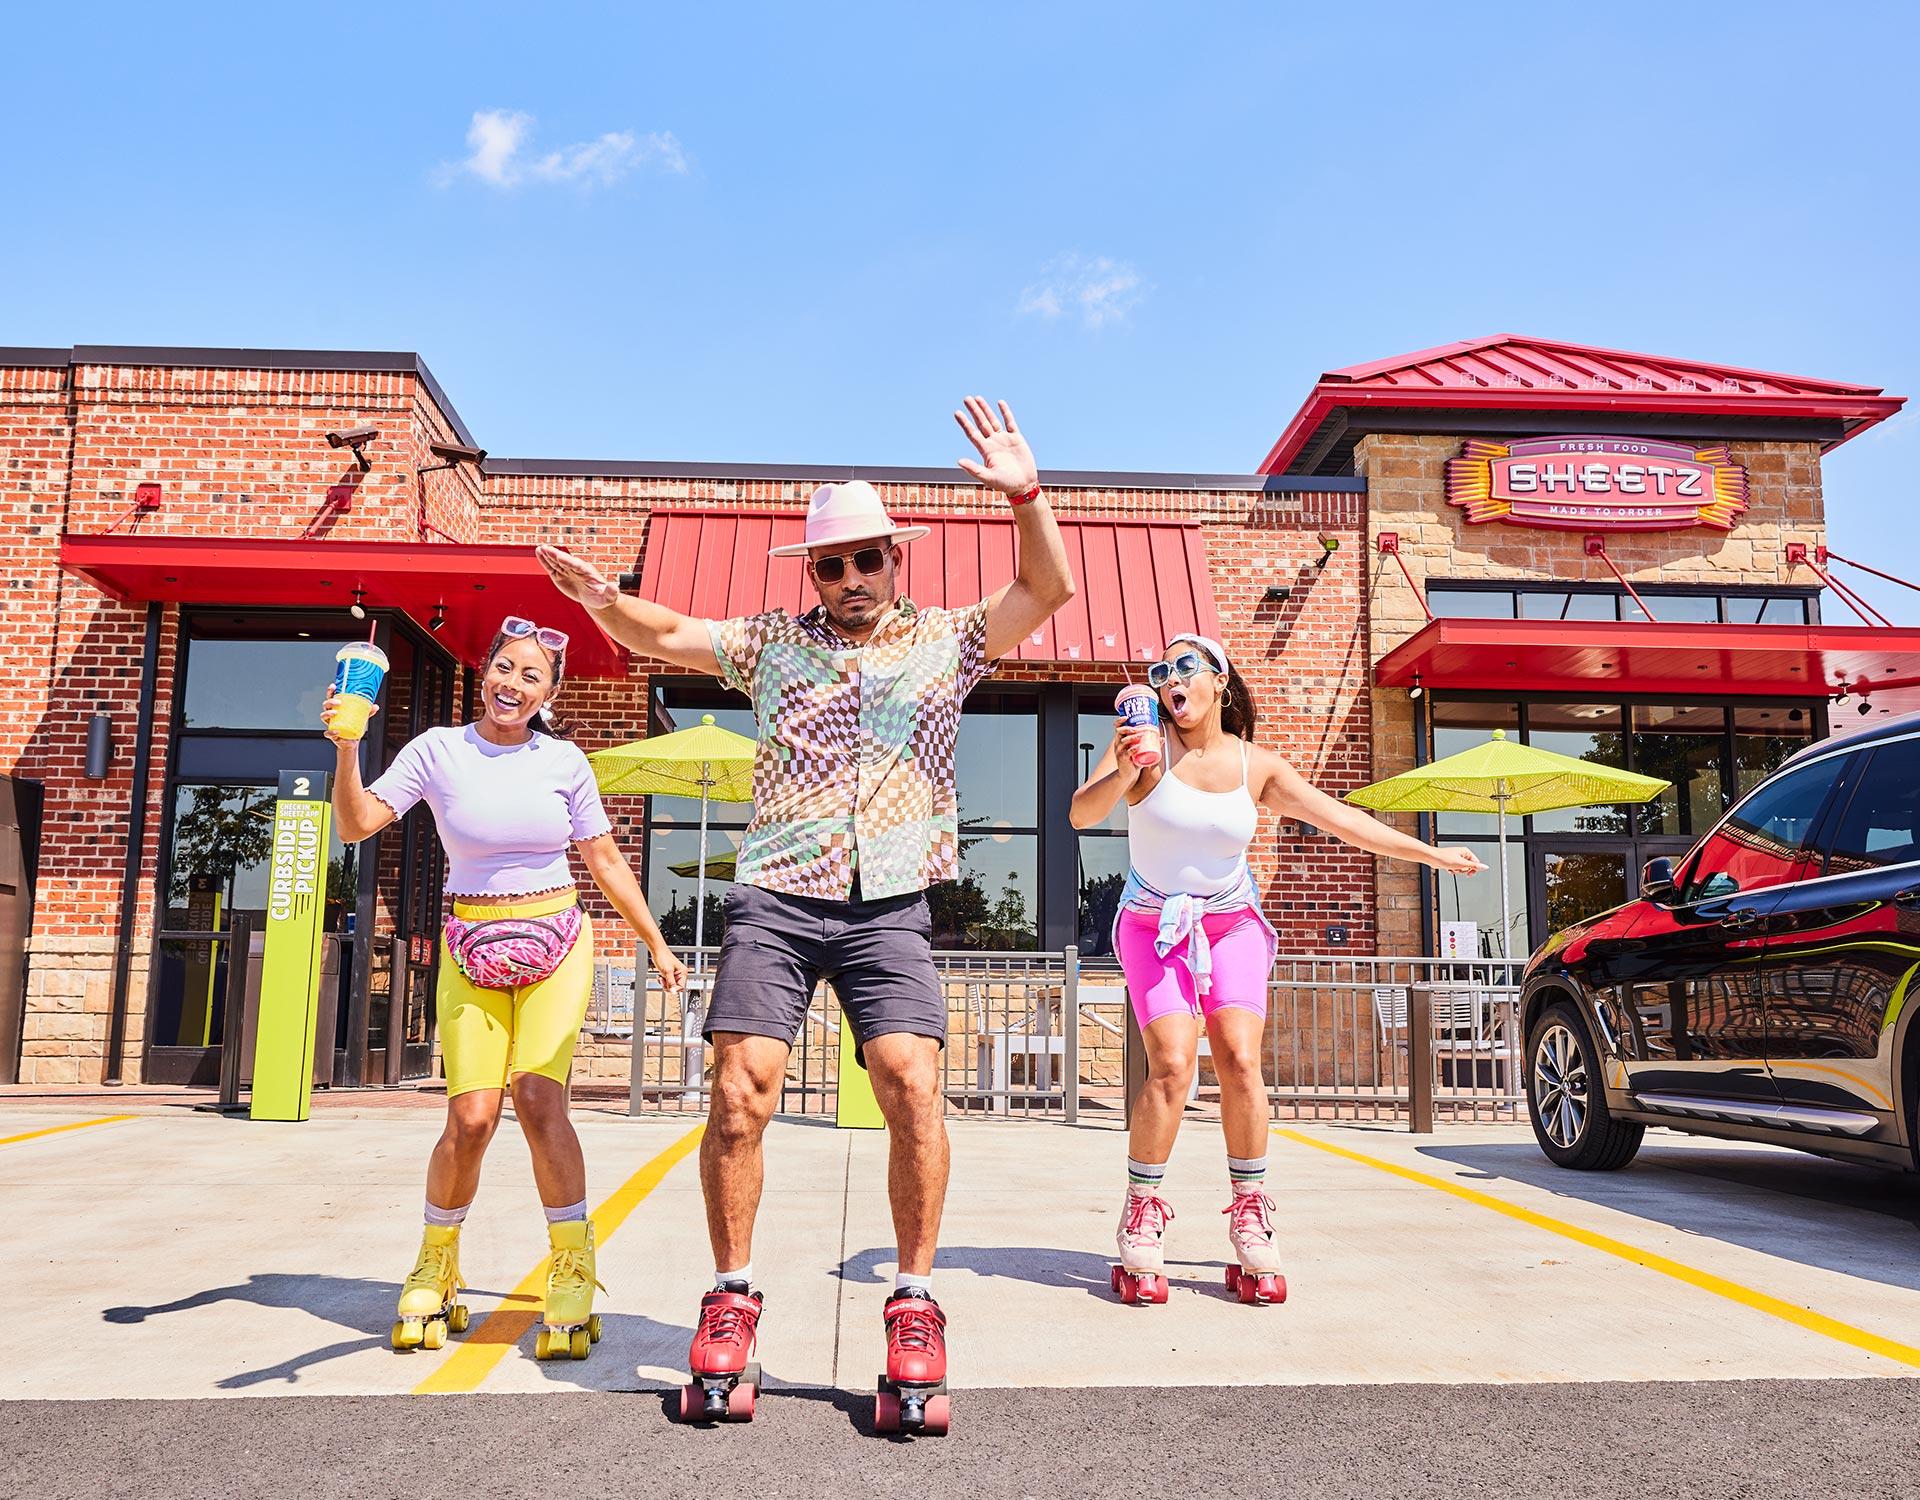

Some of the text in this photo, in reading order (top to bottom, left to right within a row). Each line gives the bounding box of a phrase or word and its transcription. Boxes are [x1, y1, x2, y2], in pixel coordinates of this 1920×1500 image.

[1560, 443, 1648, 453] FRESH FOOD
[1508, 462, 1702, 496] SHEETZ
[1549, 506, 1664, 517] MADE TO ORDER
[293, 777, 310, 796] 2
[294, 819, 319, 894] PICKUP
[271, 819, 298, 921] CURBSIDE
